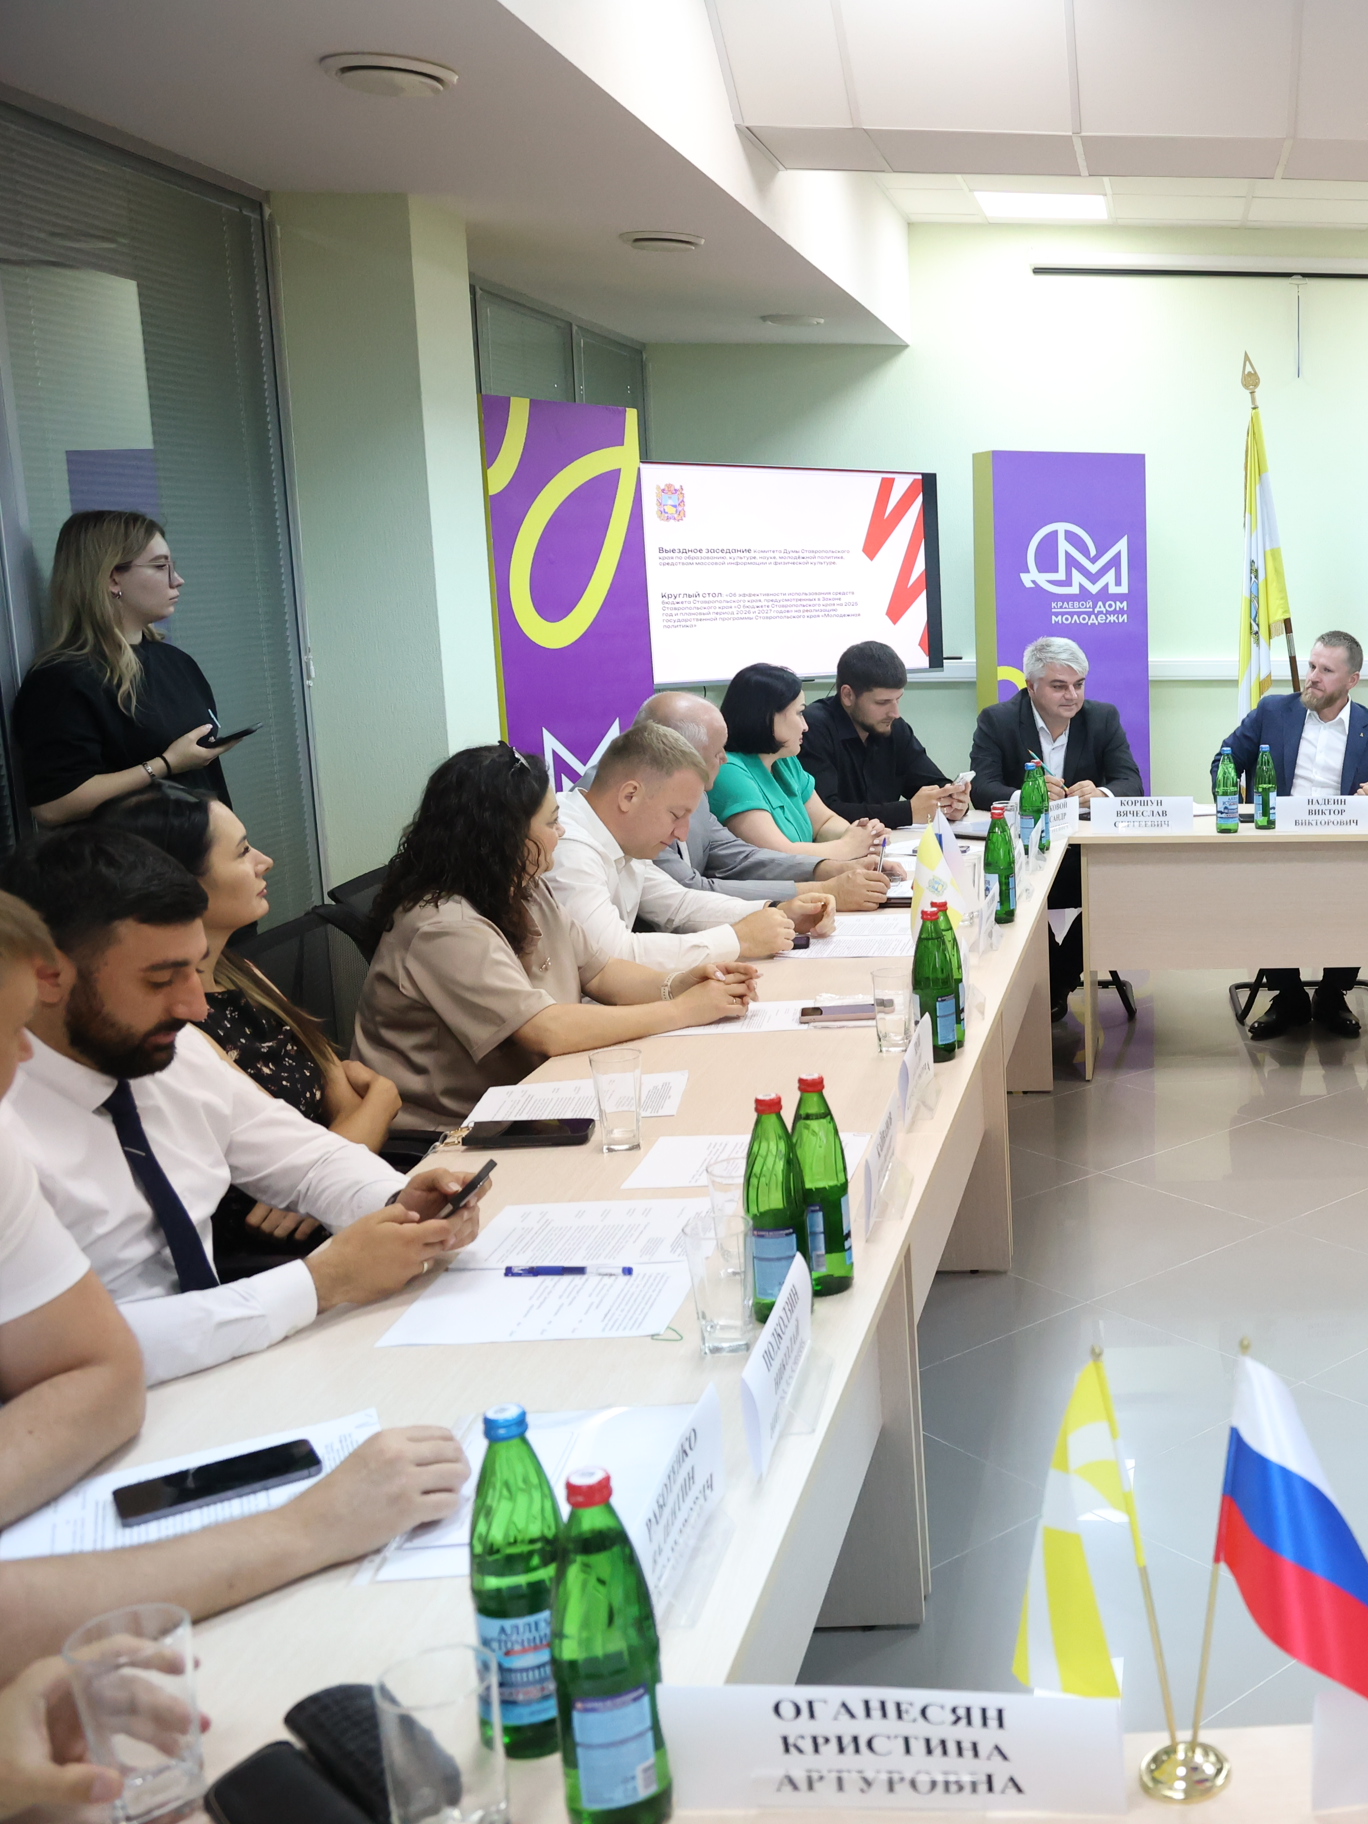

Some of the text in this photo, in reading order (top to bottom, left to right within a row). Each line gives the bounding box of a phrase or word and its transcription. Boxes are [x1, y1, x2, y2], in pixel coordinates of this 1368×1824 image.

[661, 591, 700, 600] Круглый
[1051, 600, 1093, 609] КРАЕВОЙ
[1049, 800, 1068, 812] КОВОЙ
[1120, 799, 1163, 807] КОРШУН
[1049, 812, 1067, 823] САНДР
[1116, 810, 1168, 818] ВЯЧЕСЛАВ
[1294, 819, 1359, 827] ВИКТОРОВИЧ
[762, 1283, 799, 1373] ПОДКОЛЗИН
[773, 1698, 1007, 1730] ОГАНЕСЯН
[780, 1734, 1011, 1763] КРИСТИНА
[775, 1768, 1026, 1796] АРТУРОВНА
